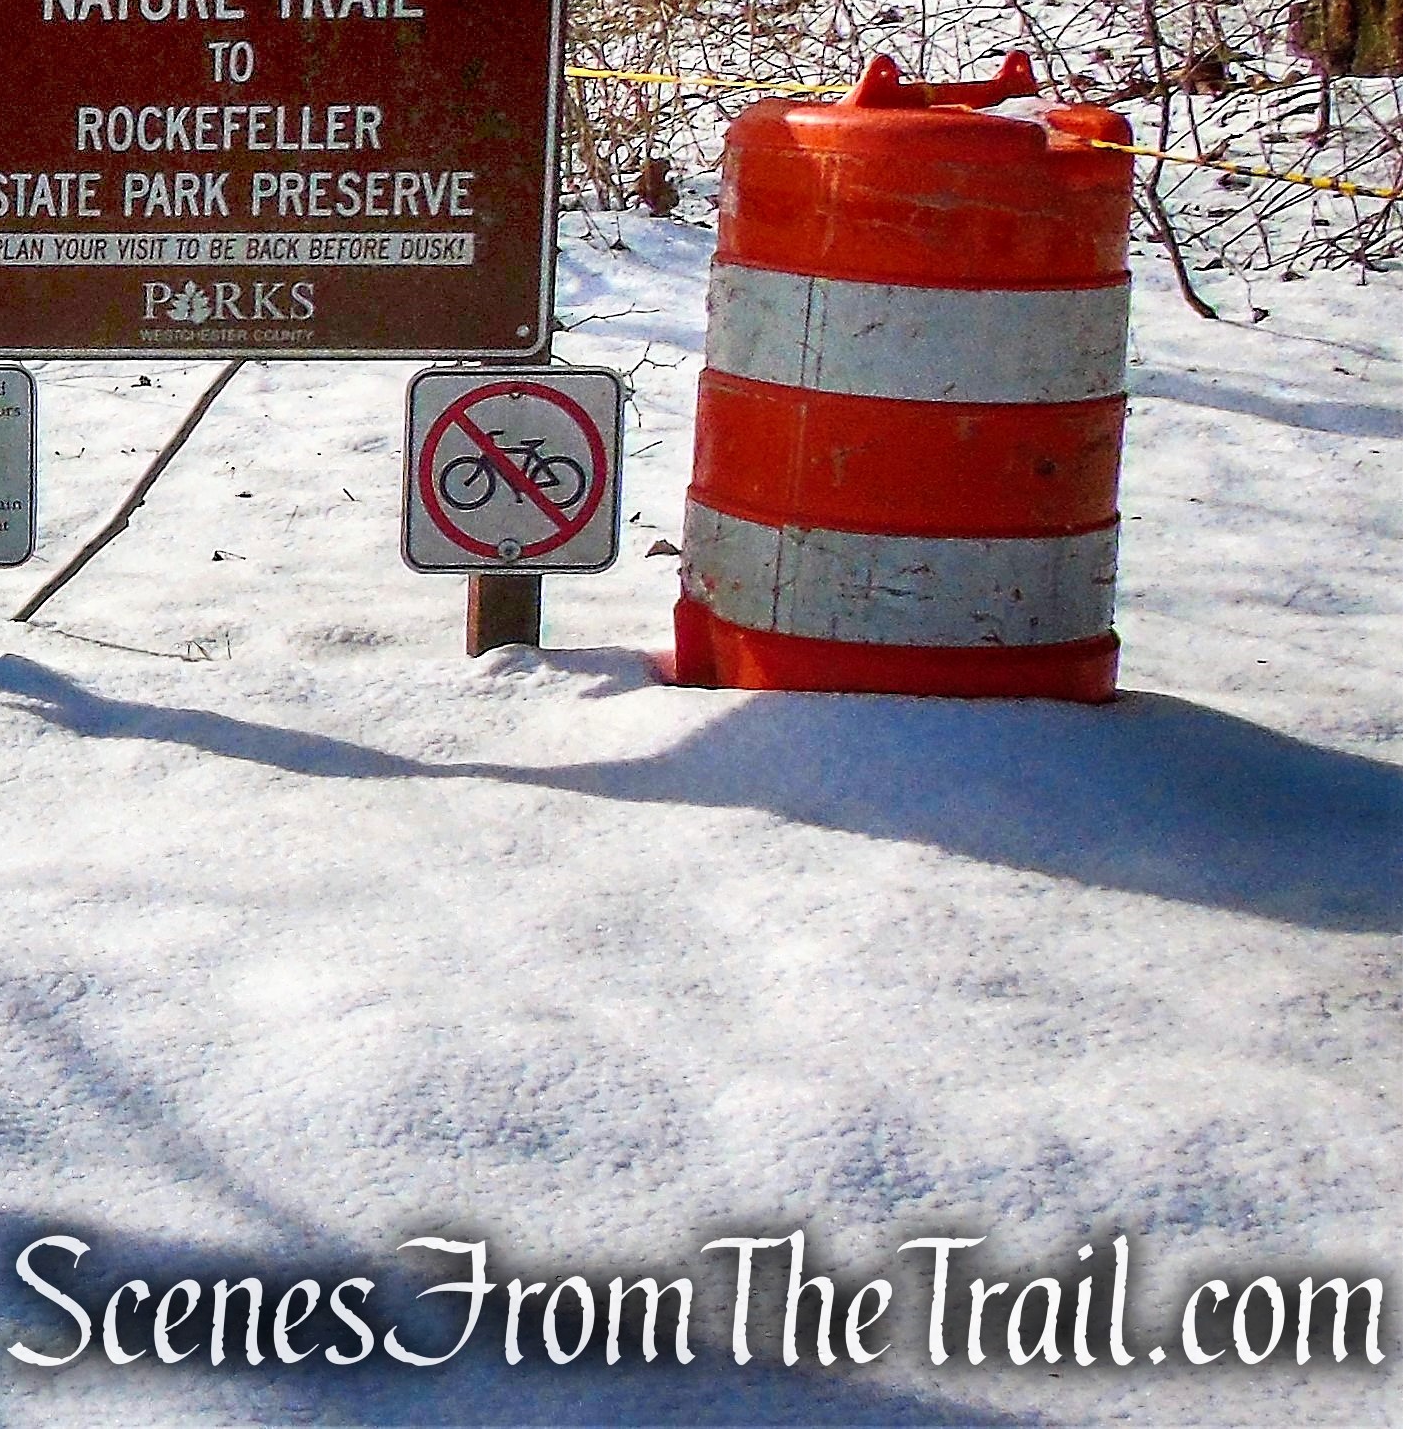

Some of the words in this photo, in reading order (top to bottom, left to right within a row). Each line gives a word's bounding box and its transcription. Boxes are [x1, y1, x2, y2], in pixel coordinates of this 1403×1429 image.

[208, 40, 255, 84] TO
[76, 105, 383, 152] ROCKEFELLER
[123, 172, 230, 217] PARK
[251, 172, 475, 217] PRESERVE
[54, 238, 108, 261] YOUR
[118, 238, 168, 260] VISIT
[176, 238, 200, 260] TO
[210, 238, 237, 260] BE
[246, 238, 300, 260] BACK
[309, 238, 392, 260] BEFORE
[400, 237, 465, 260] DUSK!
